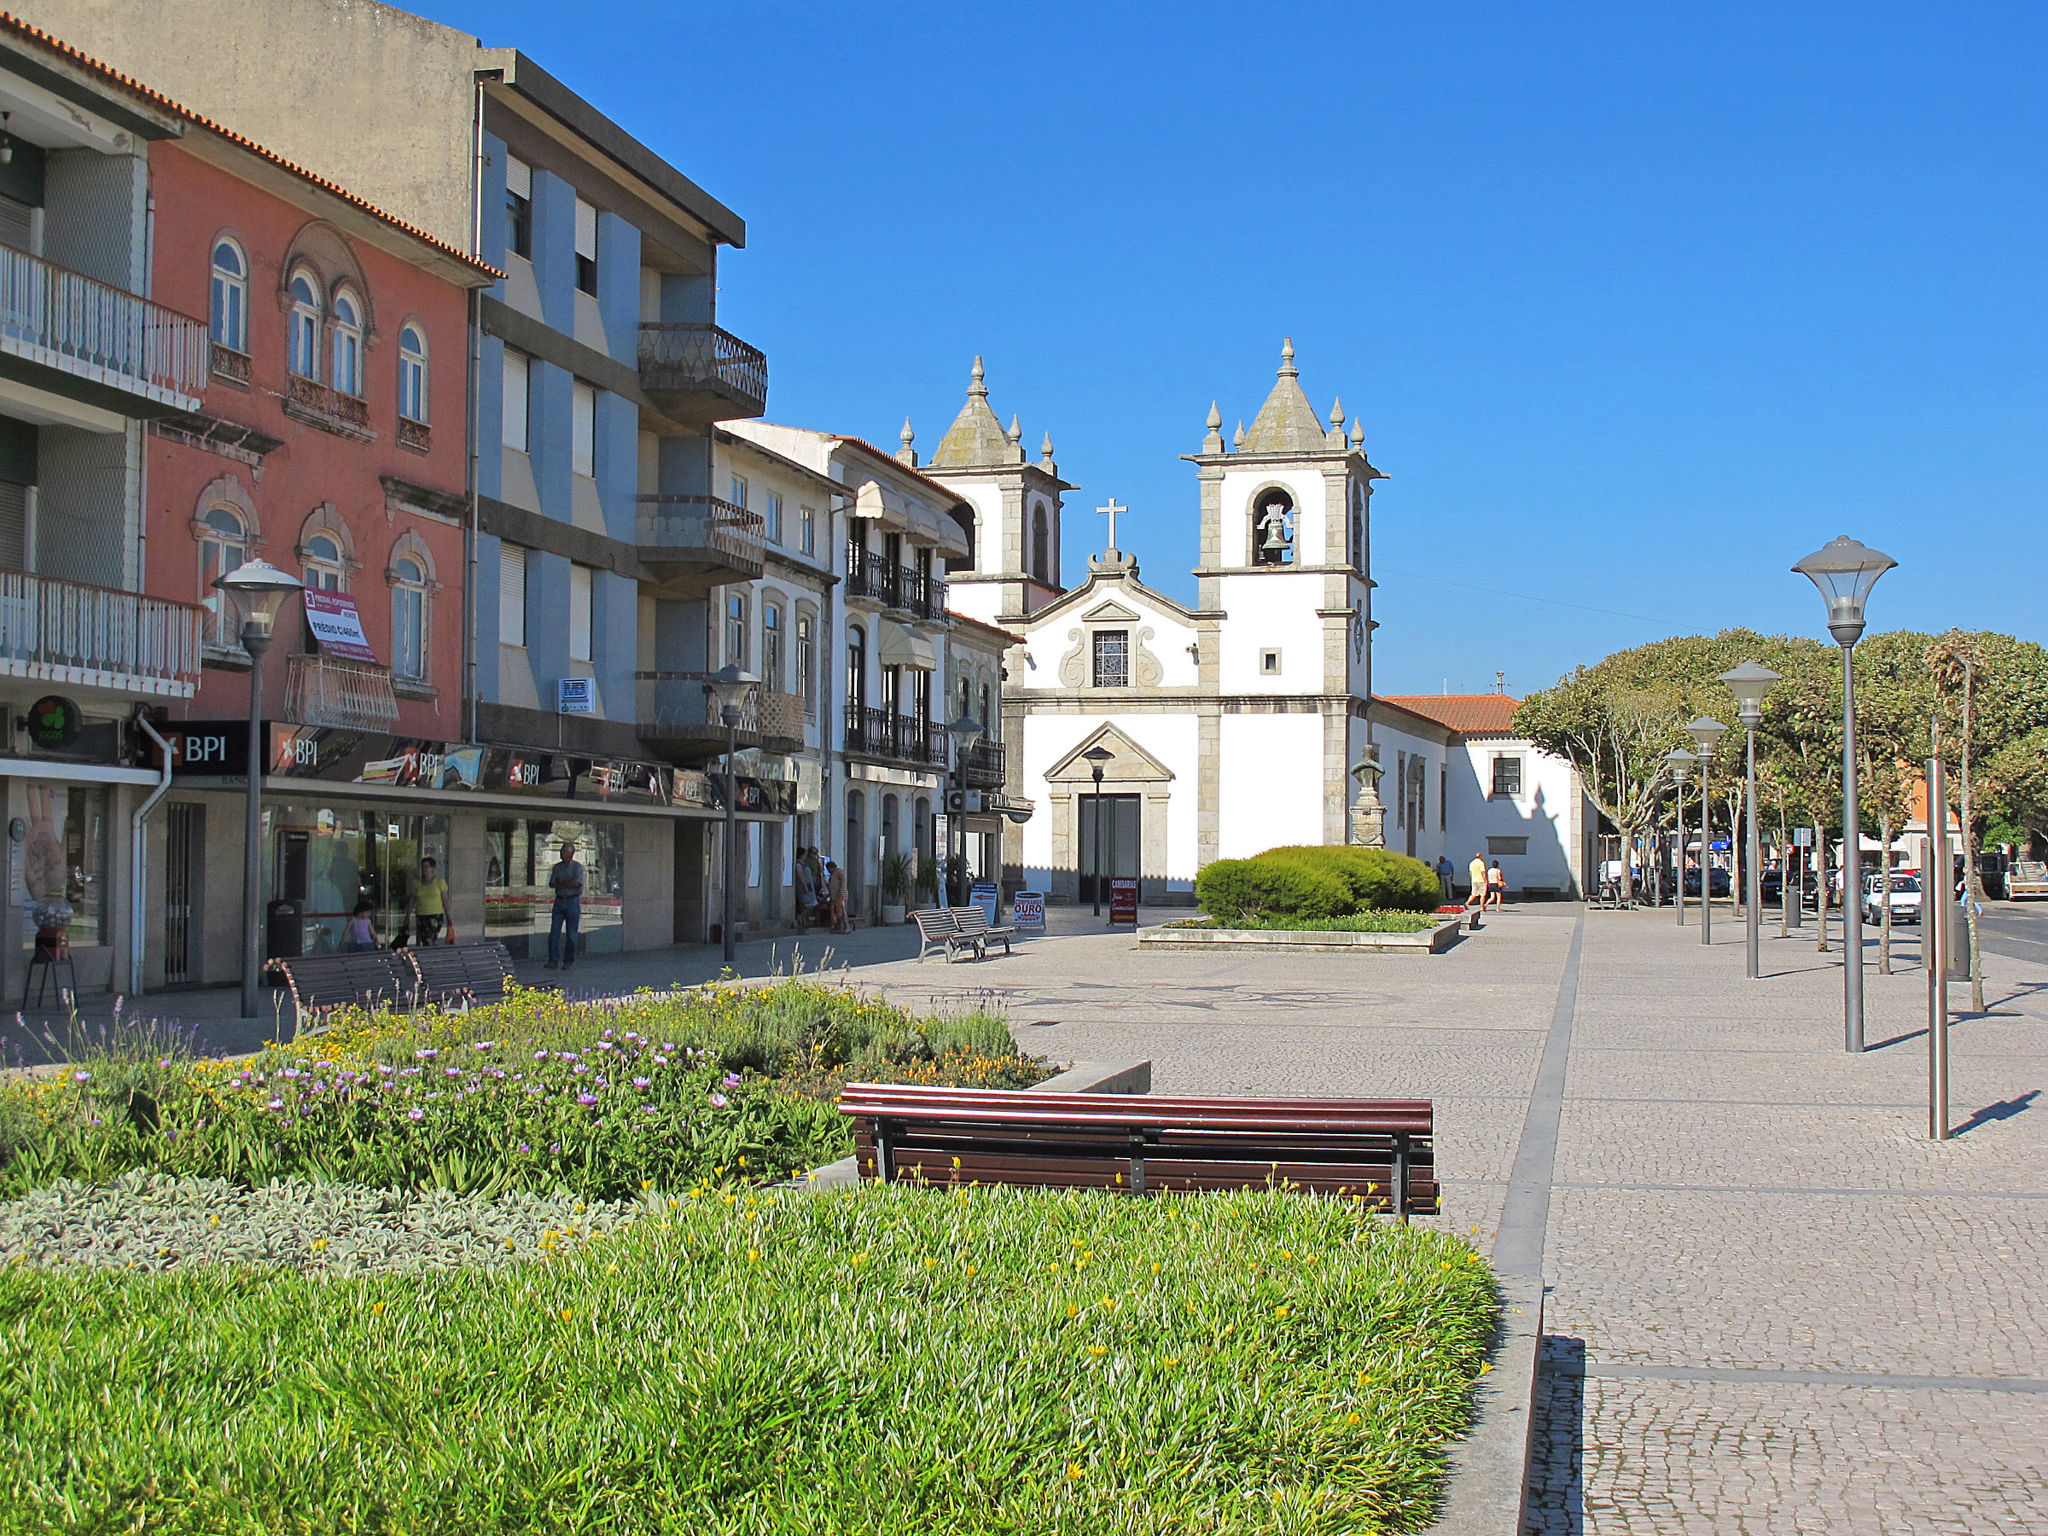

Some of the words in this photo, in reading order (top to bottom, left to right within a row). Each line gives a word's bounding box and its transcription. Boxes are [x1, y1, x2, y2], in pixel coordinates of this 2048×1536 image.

[313, 621, 337, 635] PRÉDIO
[186, 736, 226, 761] BPI
[296, 739, 318, 765] BPI
[419, 753, 438, 777] BPI
[523, 764, 540, 785] BPI
[222, 776, 249, 785] BANC
[610, 773, 625, 793] BPI
[685, 780, 698, 799] BPI
[749, 787, 760, 804] BPI
[1015, 905, 1042, 913] OURO
